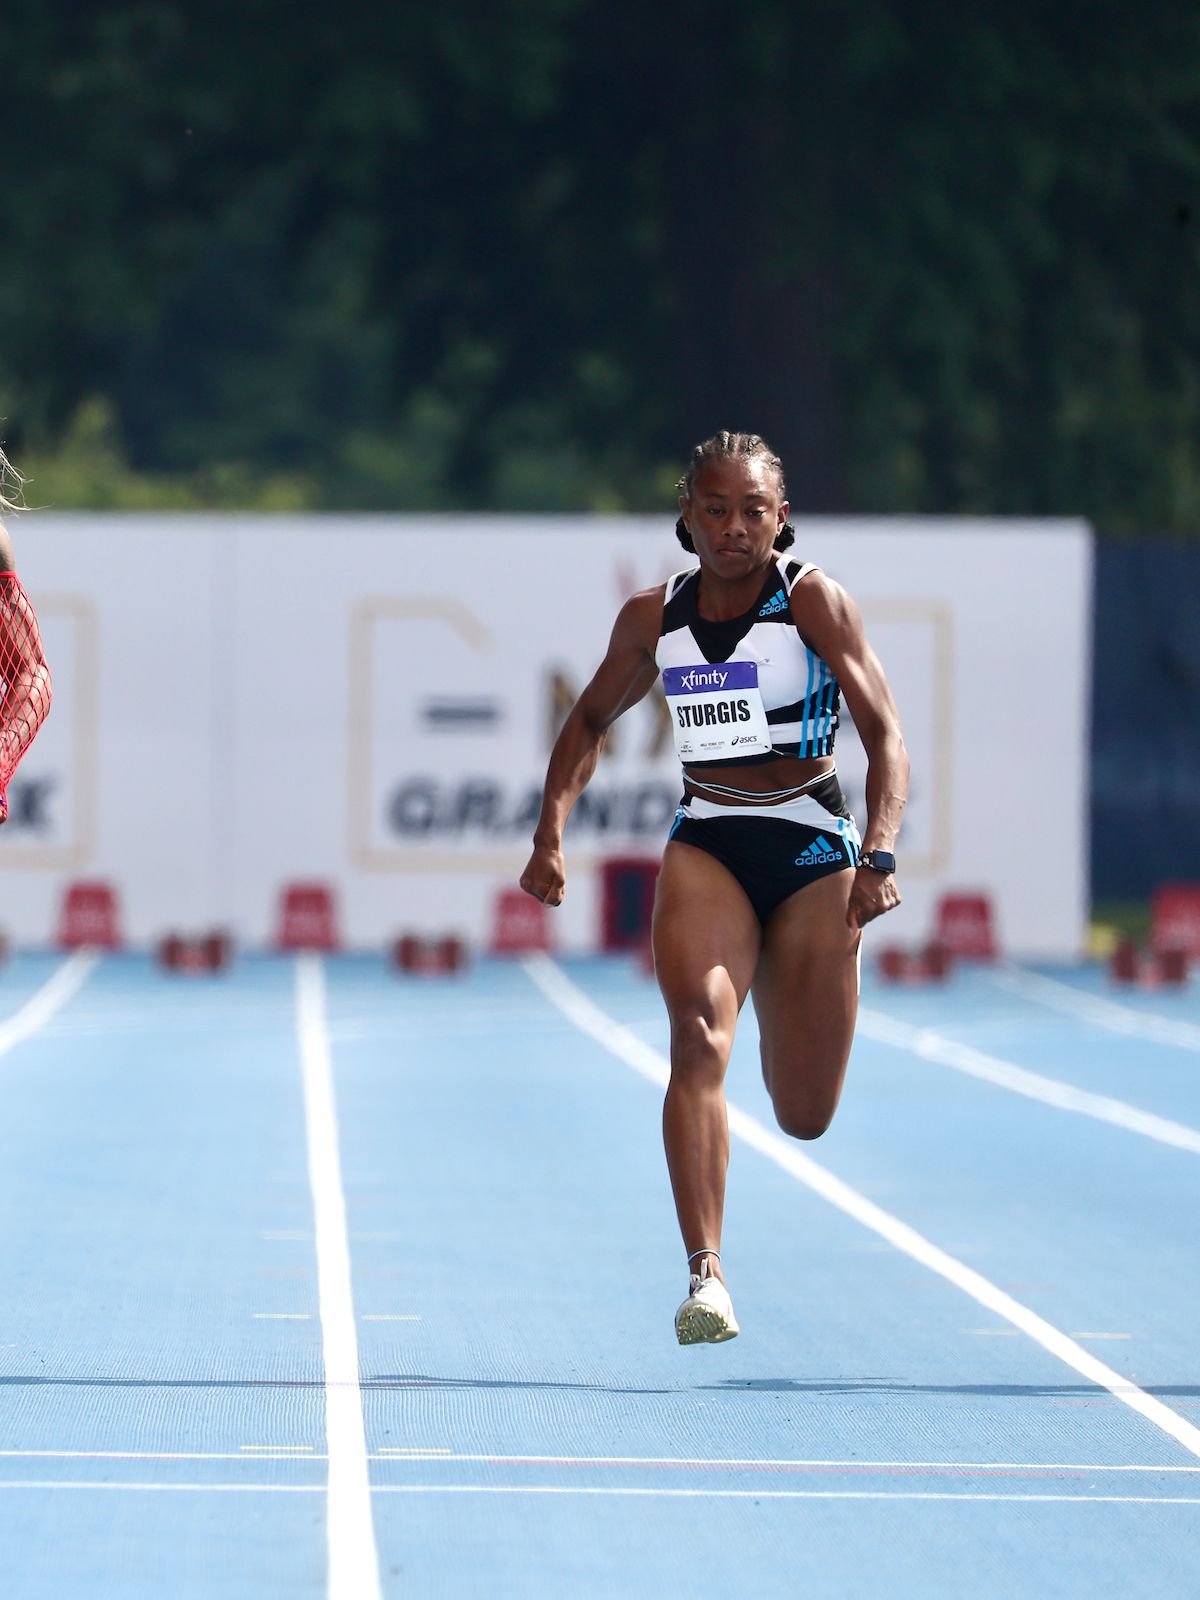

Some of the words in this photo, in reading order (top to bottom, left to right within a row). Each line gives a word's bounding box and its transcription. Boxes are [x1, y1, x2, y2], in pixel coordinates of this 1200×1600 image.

[681, 669, 728, 690] xfinity
[677, 700, 751, 728] STURGIS
[739, 735, 757, 744] asics
[795, 851, 843, 866] adidas
